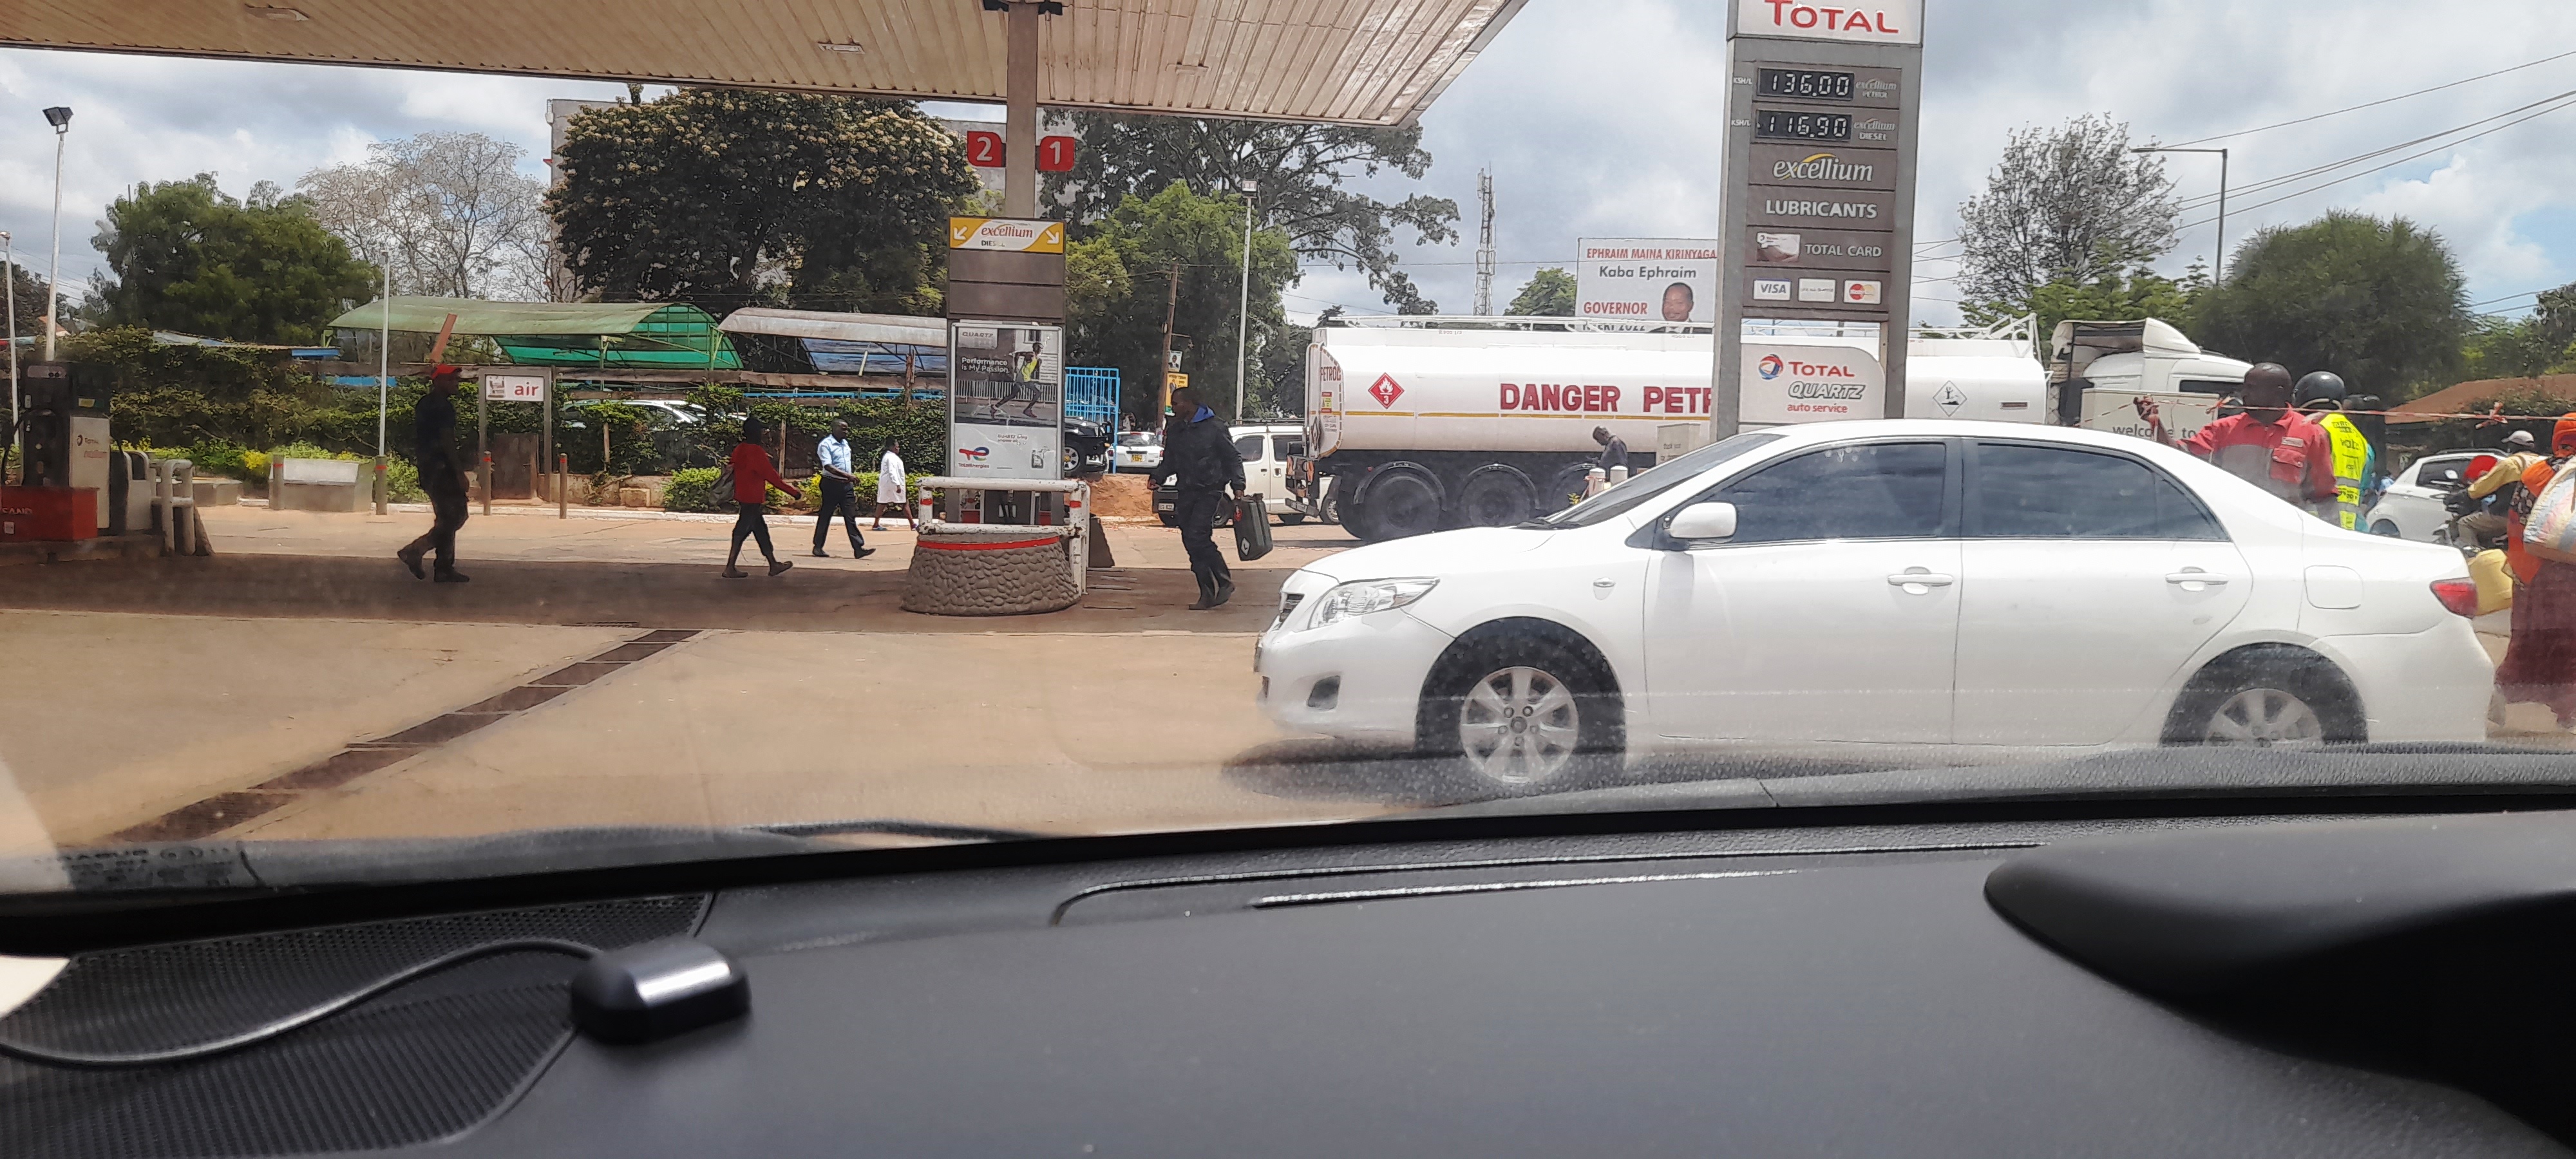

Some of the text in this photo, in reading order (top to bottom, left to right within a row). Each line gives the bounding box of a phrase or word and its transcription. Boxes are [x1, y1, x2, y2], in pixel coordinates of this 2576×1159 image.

[1765, 0, 1899, 33] TOTAL
[1859, 132, 1887, 140] DIESEL
[976, 136, 993, 162] 2
[1049, 140, 1061, 165] 1
[1773, 157, 1874, 182] excellium
[1765, 200, 1878, 219] LUBRICANTS
[981, 225, 1033, 238] excellium
[1587, 248, 1718, 259] EPHRAIM MAINA KIRINYAGA
[1804, 243, 1882, 258] TOTAL CARD
[1599, 265, 1696, 281] Kaba Ephraim
[1760, 283, 1787, 294] VISA
[1584, 302, 1648, 315] GOVERNOR
[961, 357, 1009, 366] Performance
[1788, 361, 1855, 377] TOTAL
[514, 381, 539, 397] air
[1788, 381, 1866, 400] QUARTZ
[1383, 395, 1390, 404] 3
[1500, 383, 1621, 412] DANGER
[1787, 403, 1848, 413] auto service
[2112, 423, 2174, 438] welcoe
